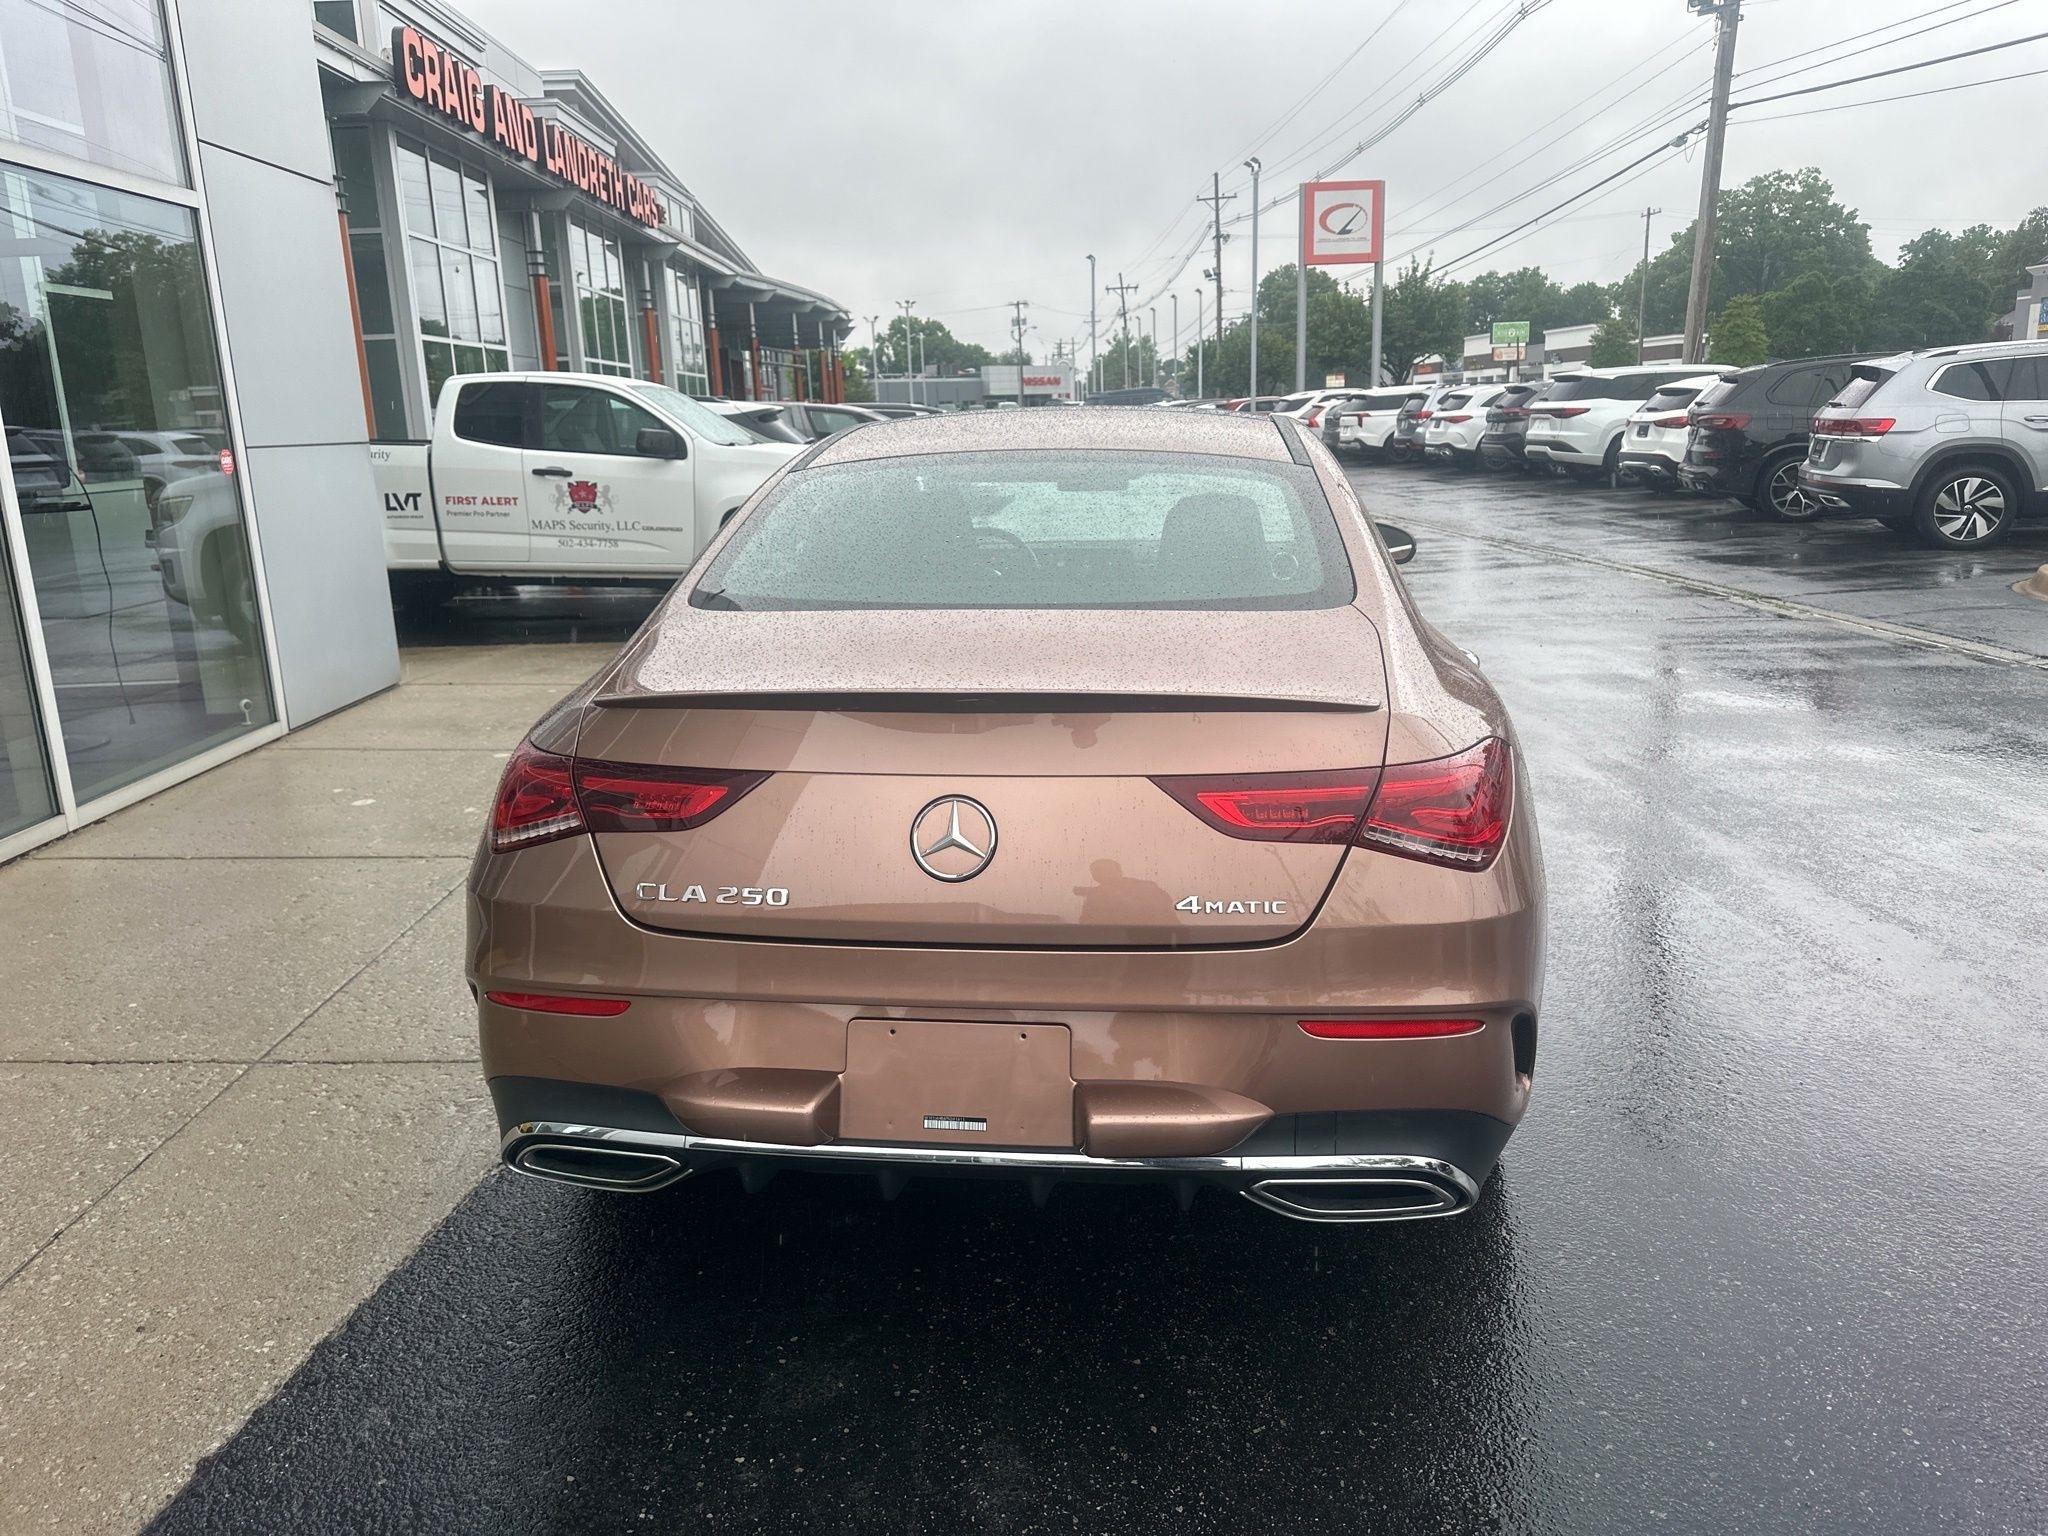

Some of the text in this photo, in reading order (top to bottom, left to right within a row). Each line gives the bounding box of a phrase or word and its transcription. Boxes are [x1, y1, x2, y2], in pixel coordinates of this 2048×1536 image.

[401, 25, 659, 229] CRAIG AND LANDRETH CARS
[1023, 376, 1062, 387] NISSAN
[384, 492, 422, 512] LVT
[445, 496, 519, 506] FIRST ALERT
[531, 519, 641, 533] MAPS Security, LLC
[558, 538, 619, 548] 502-434-7758
[636, 882, 790, 906] CLA 250
[1175, 895, 1288, 914] 4MATIC
